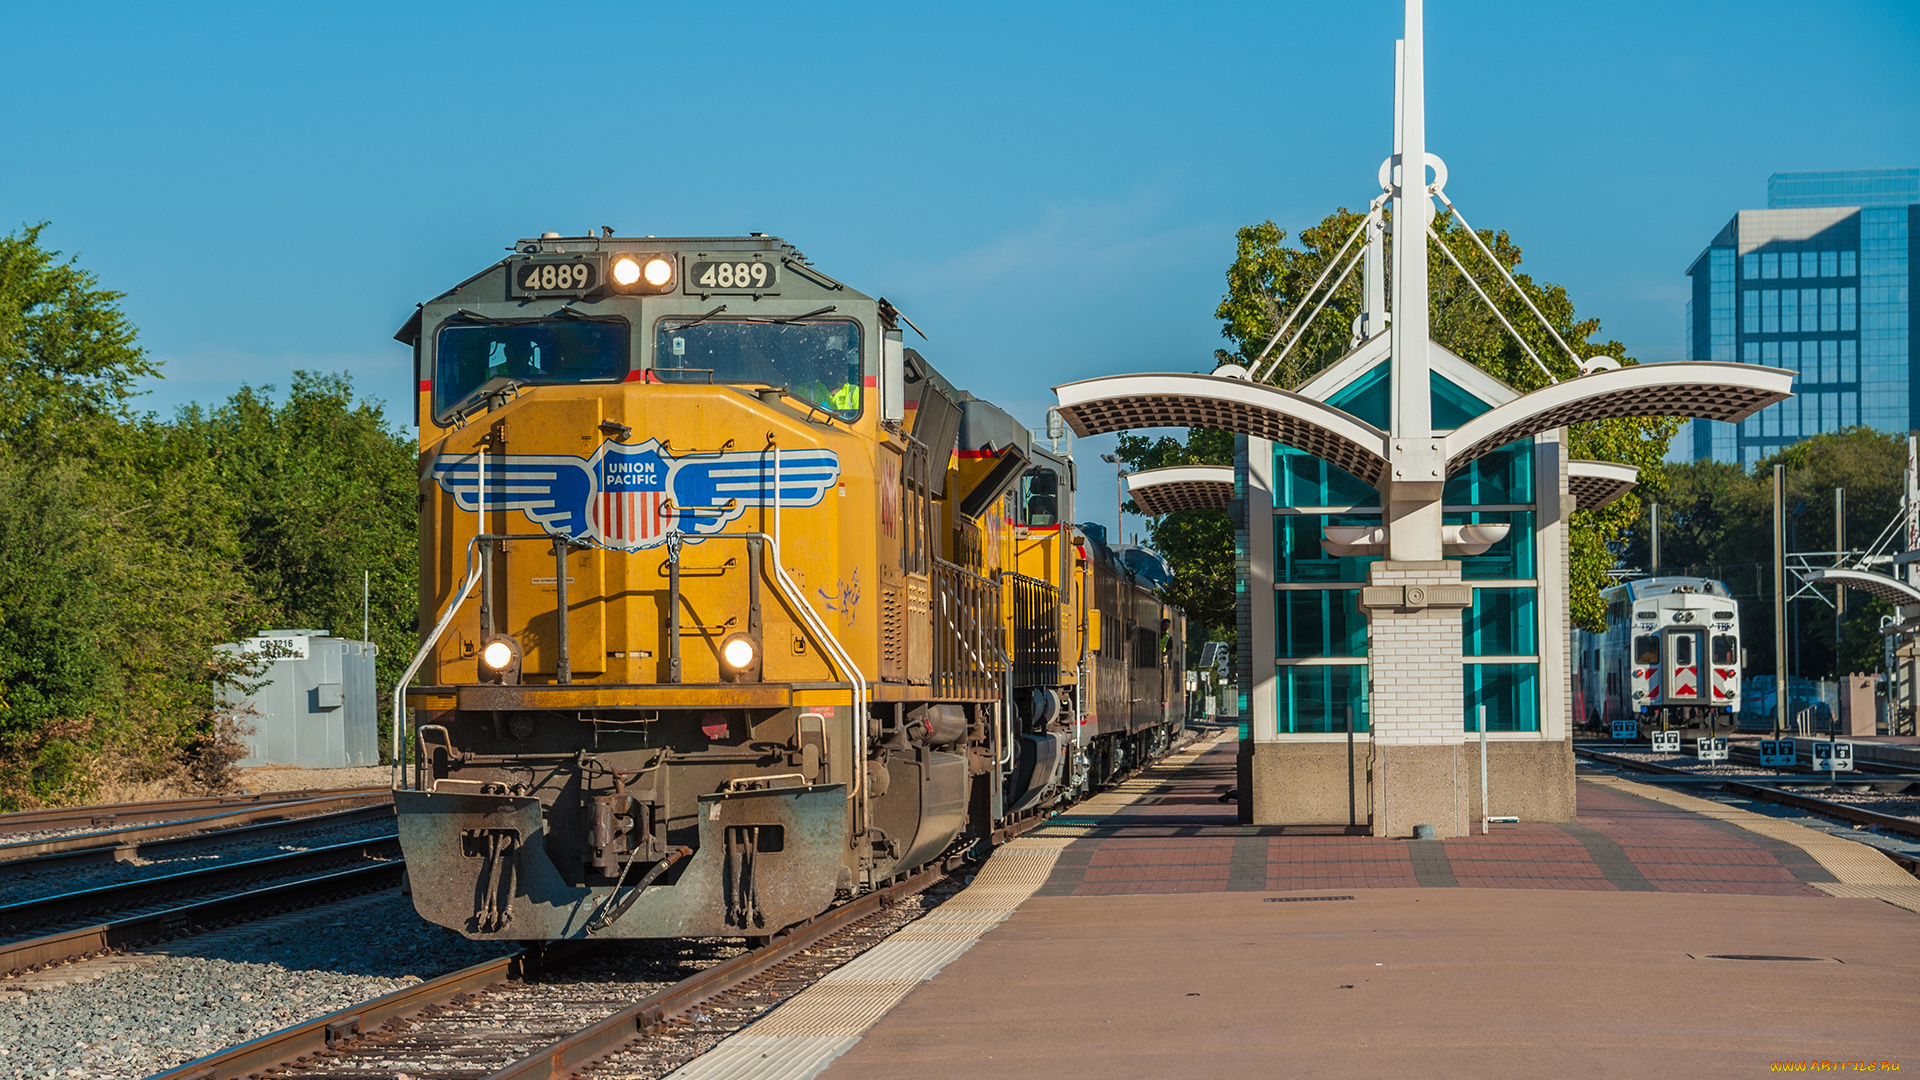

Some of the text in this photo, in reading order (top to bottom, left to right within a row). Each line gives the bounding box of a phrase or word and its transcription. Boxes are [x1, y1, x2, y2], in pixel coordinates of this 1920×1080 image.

[525, 263, 589, 290] 4889
[699, 262, 768, 288] 4889
[608, 462, 655, 473] UNION
[606, 474, 658, 485] PACIFIC
